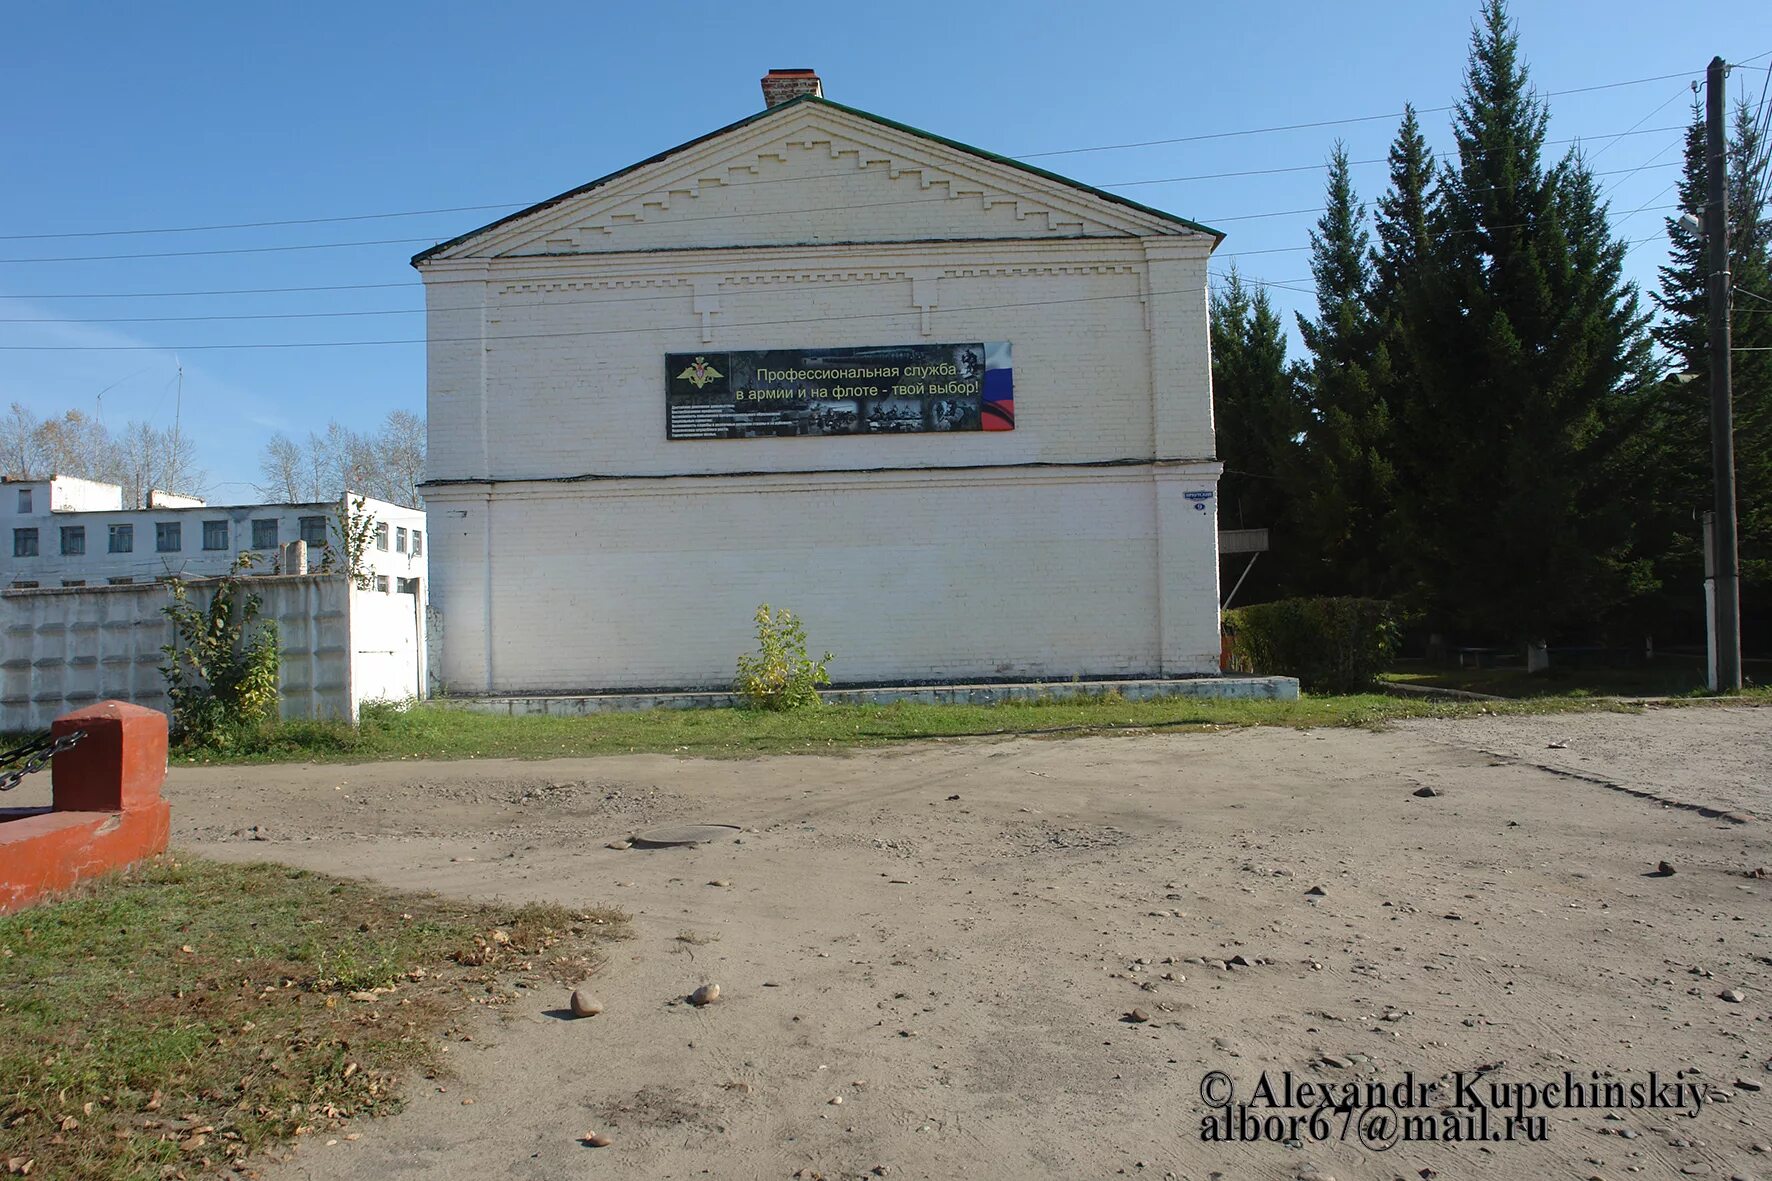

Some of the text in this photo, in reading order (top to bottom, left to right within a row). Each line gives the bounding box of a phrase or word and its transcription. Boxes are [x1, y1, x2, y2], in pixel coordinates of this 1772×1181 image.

[756, 363, 957, 382] Профессиональная служба
[736, 390, 744, 400] в
[748, 389, 793, 401] армии
[798, 389, 806, 398] и
[811, 388, 828, 398] на
[832, 384, 878, 399] флоте
[892, 381, 924, 396] твой
[929, 381, 979, 396] выбор!
